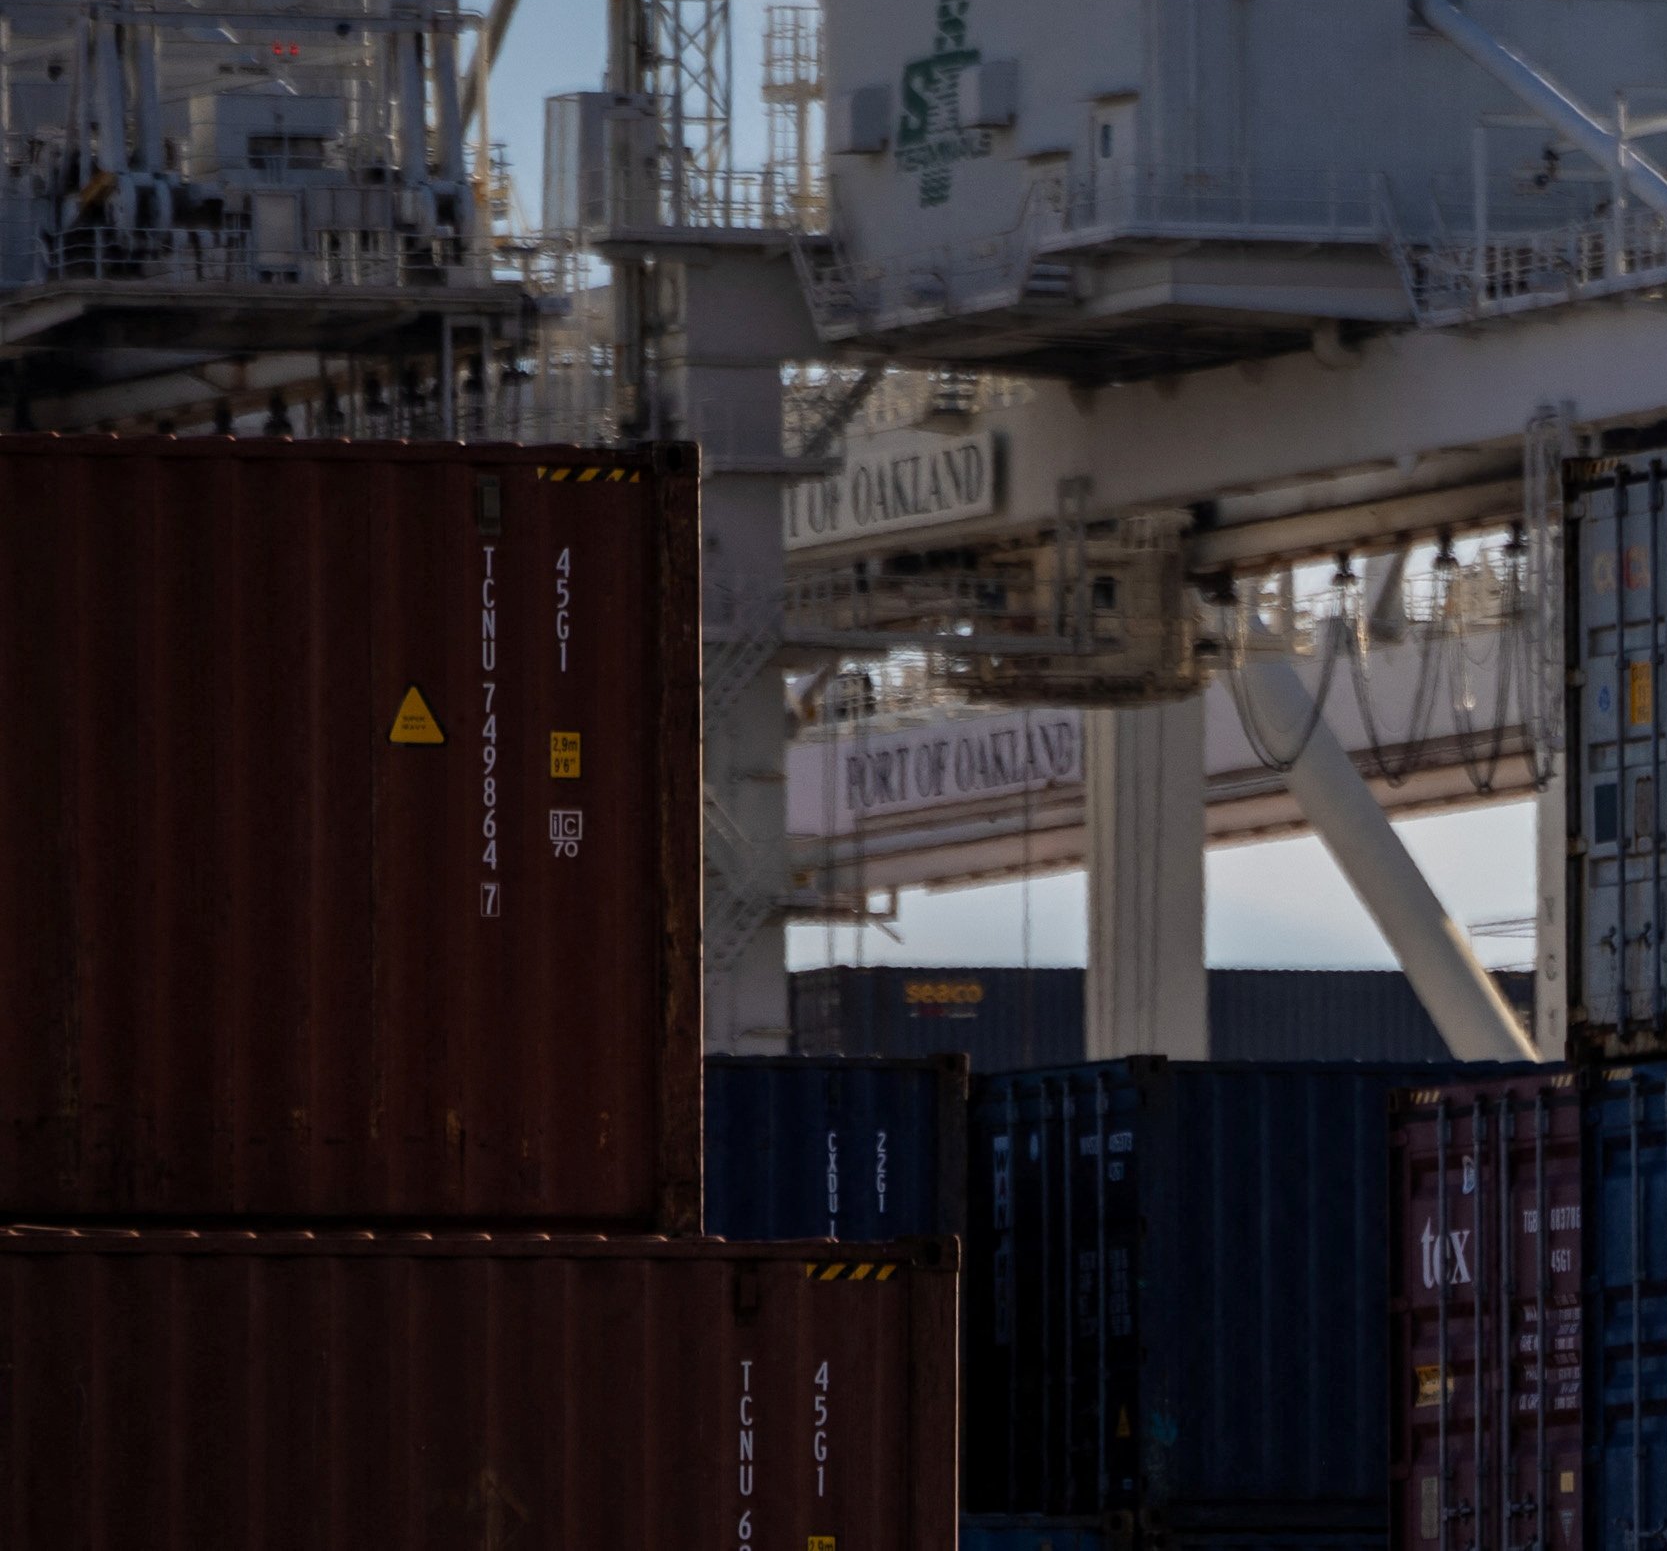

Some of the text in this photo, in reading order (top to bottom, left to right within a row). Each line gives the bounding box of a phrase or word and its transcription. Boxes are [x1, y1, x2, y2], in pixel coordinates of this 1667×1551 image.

[482, 545, 497, 672] TCNU
[555, 547, 570, 673] 45G1
[482, 683, 497, 870] 749864
[552, 841, 578, 858] 70
[904, 983, 985, 1004] seaco
[826, 1130, 839, 1212] CXDU
[875, 1130, 888, 1213] 22G1
[737, 1359, 754, 1551] TCNU 6
[813, 1359, 830, 1498] 45G1
